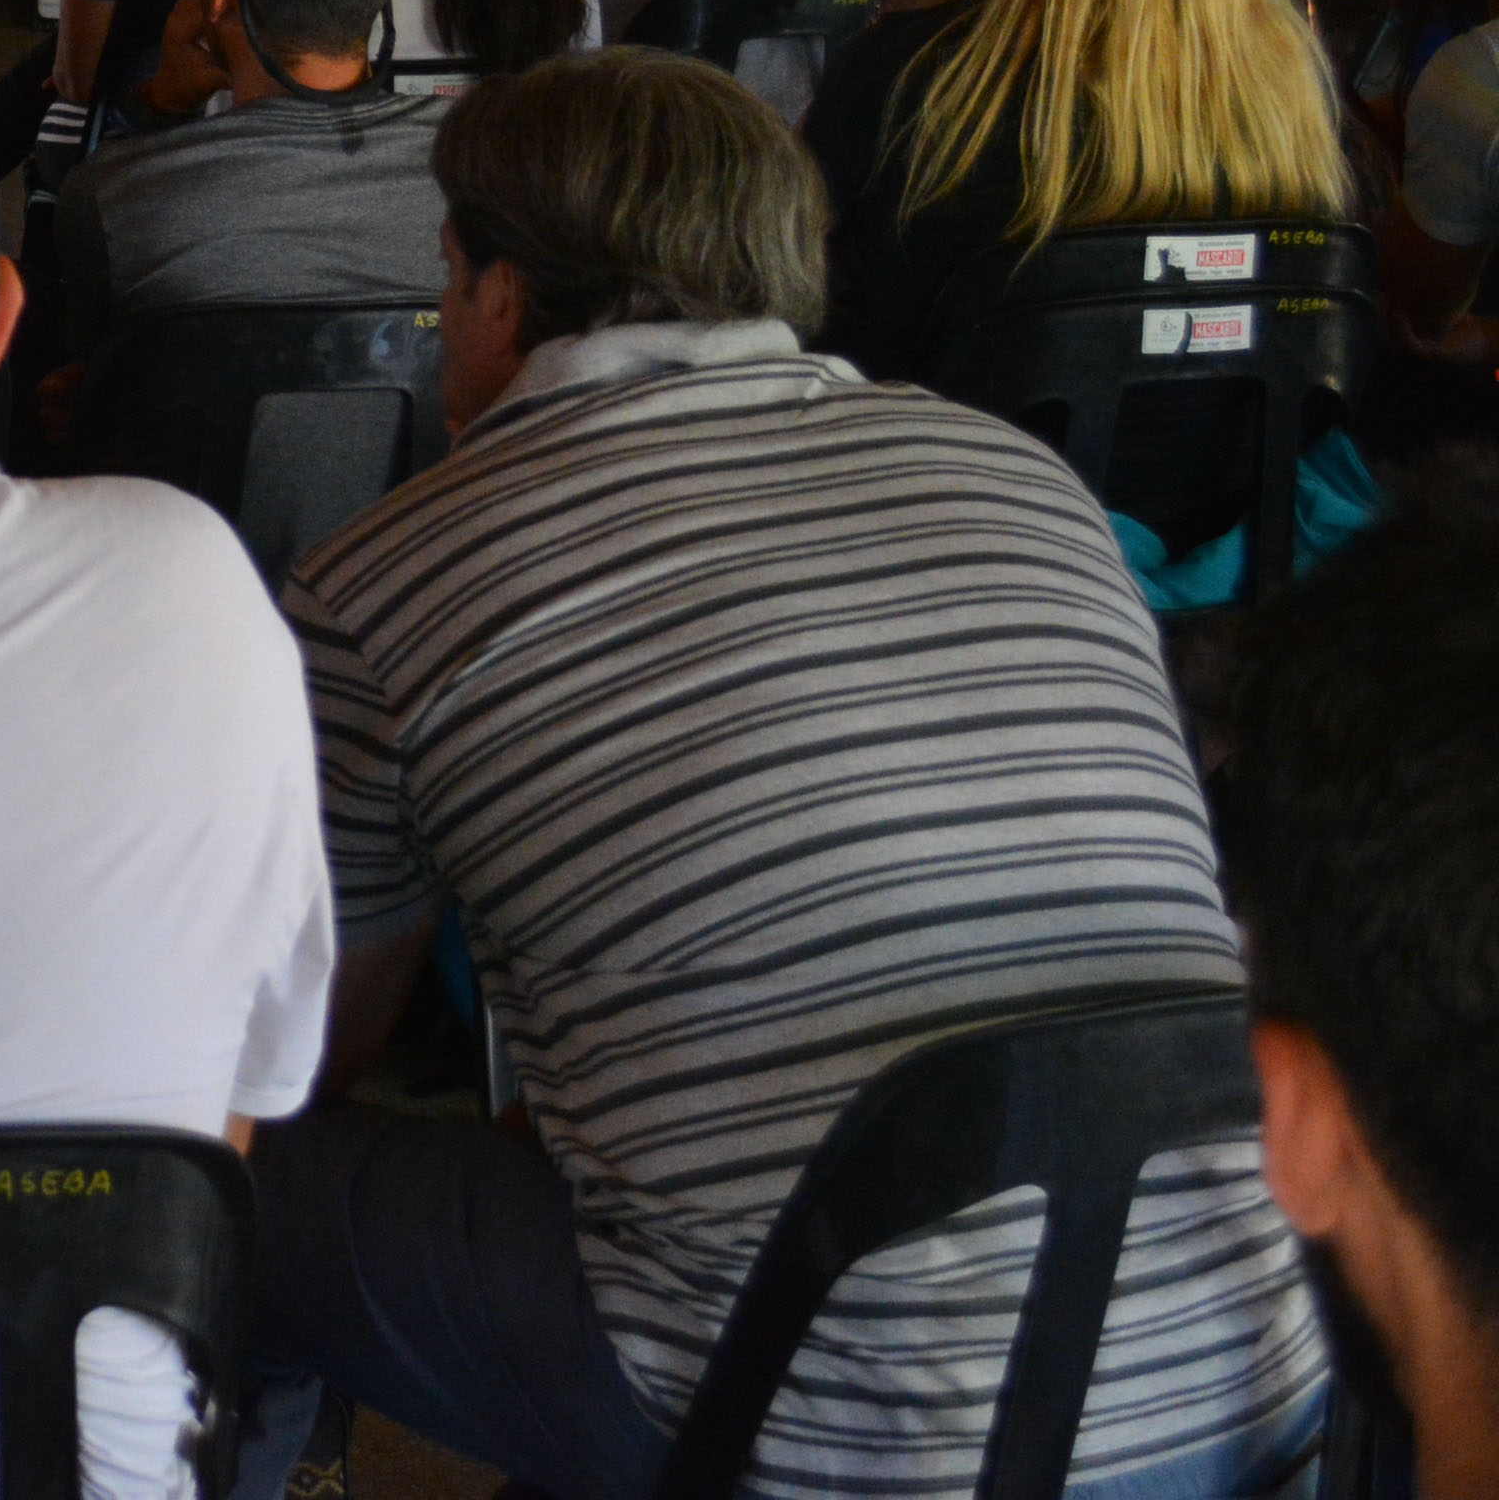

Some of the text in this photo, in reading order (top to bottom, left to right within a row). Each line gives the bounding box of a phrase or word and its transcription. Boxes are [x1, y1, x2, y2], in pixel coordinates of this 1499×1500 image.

[1269, 230, 1326, 244] ASEBA
[1198, 251, 1244, 265] MASCARDI
[1277, 298, 1331, 313] ASEBA
[1195, 322, 1240, 337] MASCARDI
